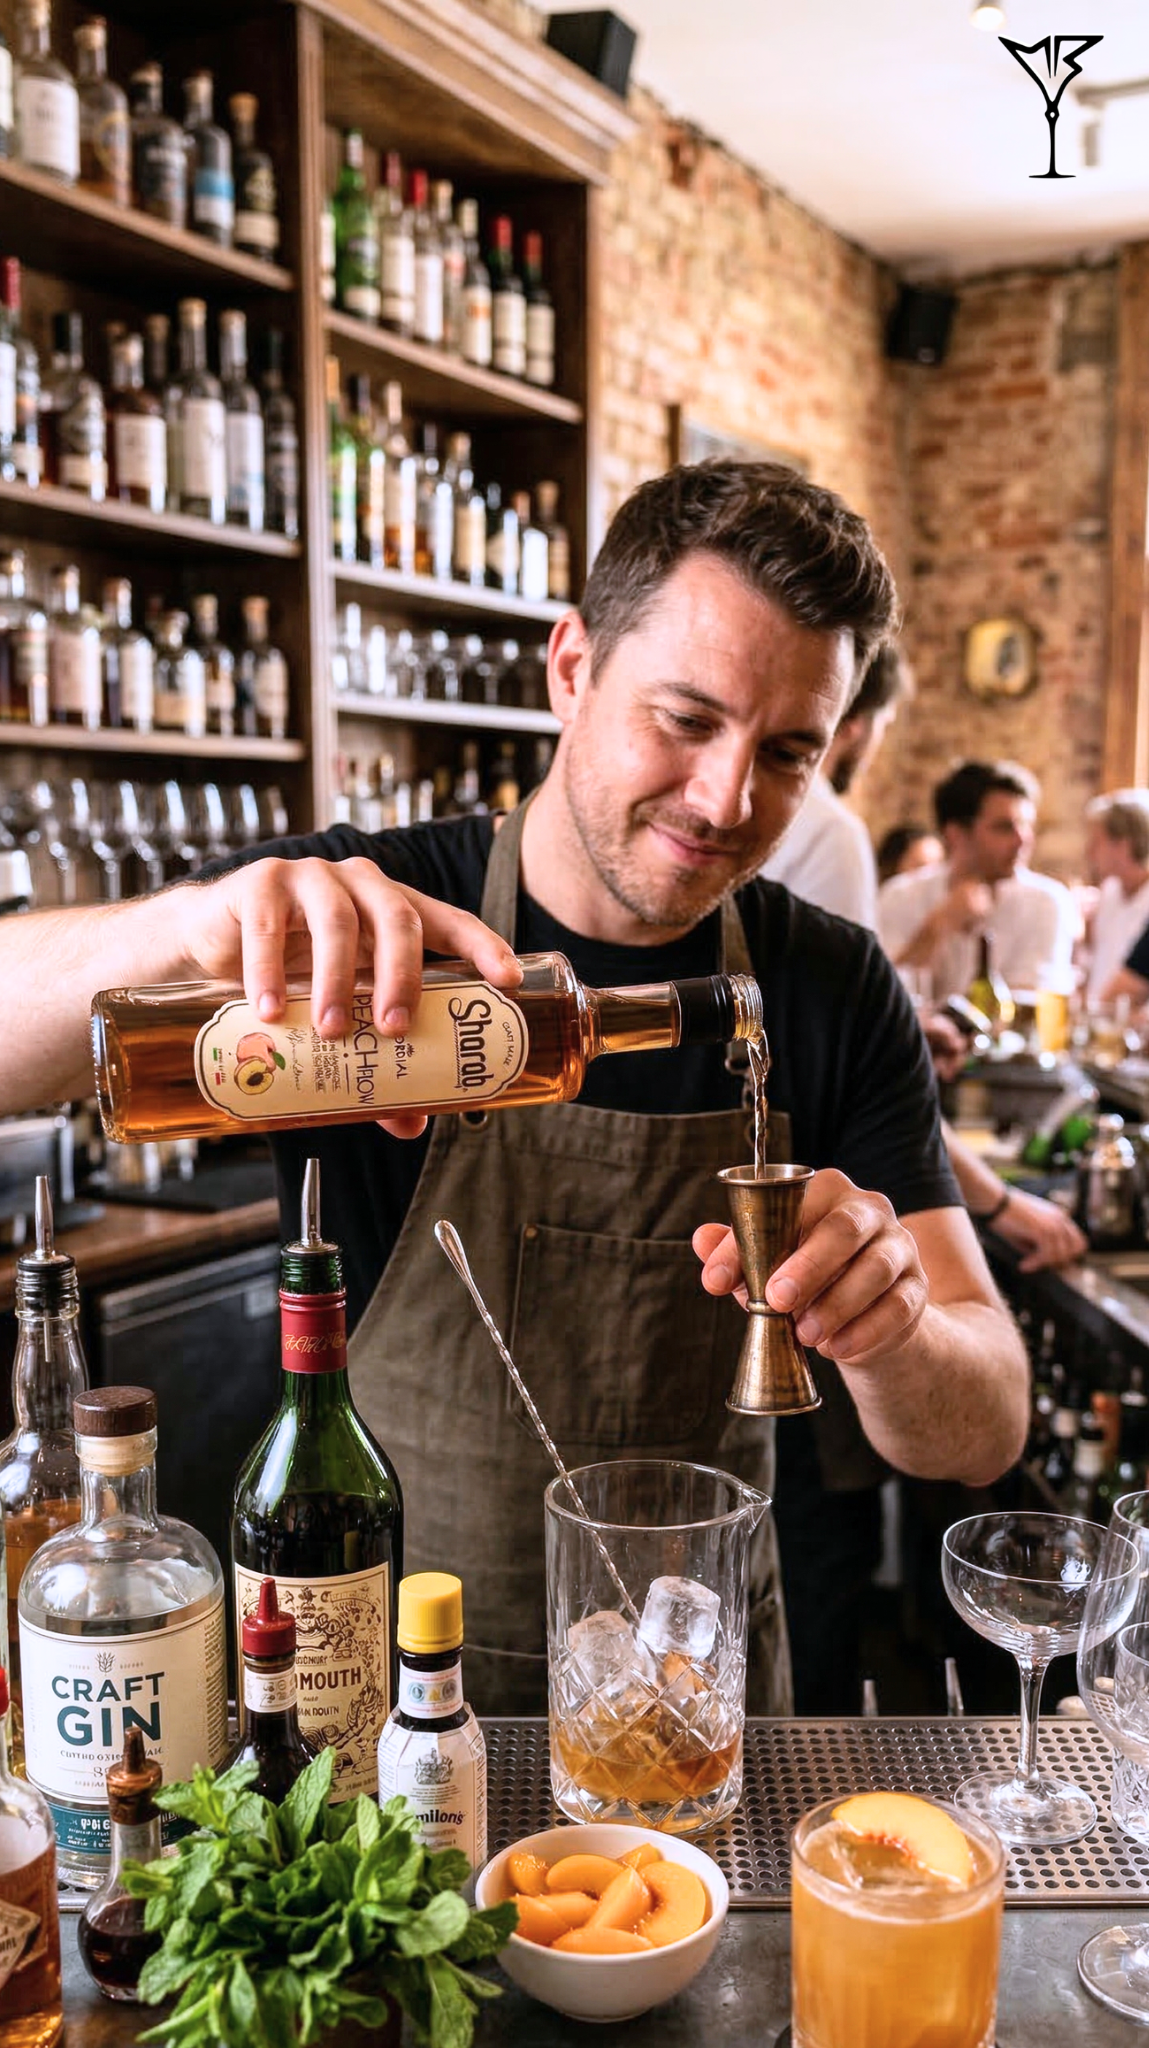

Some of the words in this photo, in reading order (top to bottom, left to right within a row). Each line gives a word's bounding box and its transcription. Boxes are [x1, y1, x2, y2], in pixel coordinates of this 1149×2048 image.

[394, 1035, 408, 1080] ORDIAL
[448, 997, 494, 1088] Sharab
[52, 1672, 165, 1702] CRAFT
[295, 1666, 361, 1691] MOUTH
[57, 1702, 161, 1747] GIN
[416, 1809, 464, 1826] milon's
